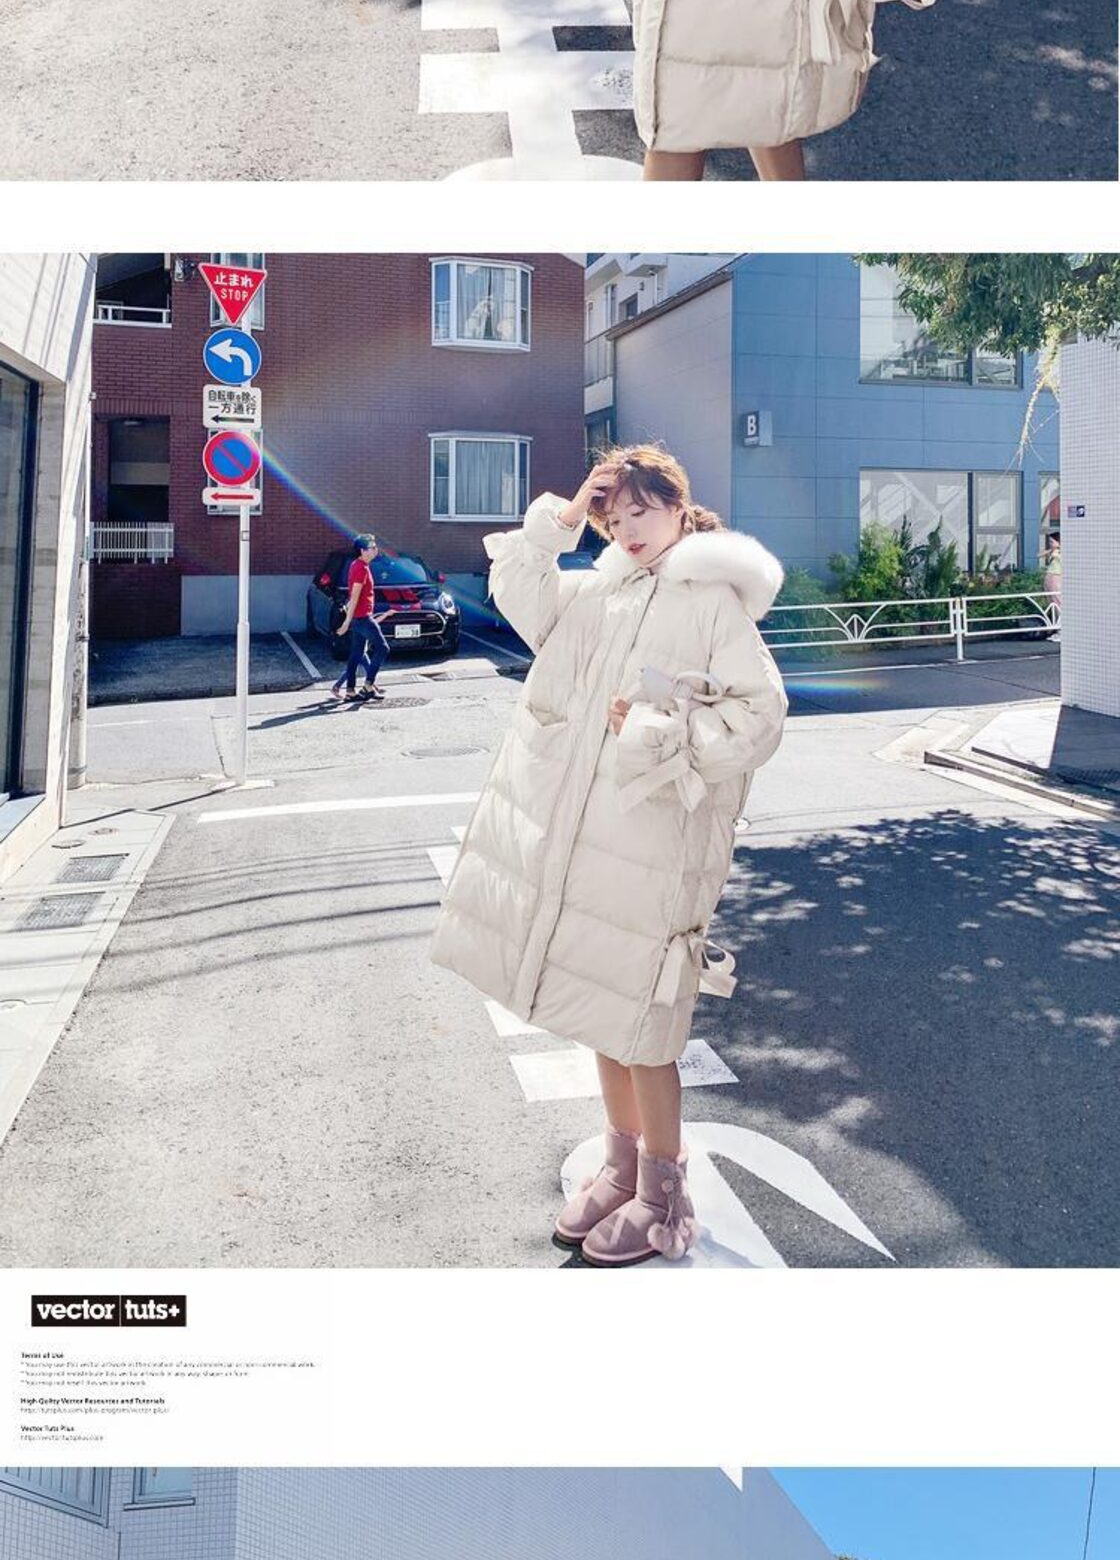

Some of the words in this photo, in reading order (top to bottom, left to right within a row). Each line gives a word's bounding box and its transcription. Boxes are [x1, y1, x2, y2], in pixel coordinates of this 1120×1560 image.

[213, 271, 254, 288] 止まれ
[220, 288, 248, 301] STOP
[208, 389, 256, 404] 自転車を除く
[208, 402, 256, 415] 一方通行
[747, 414, 757, 436] B
